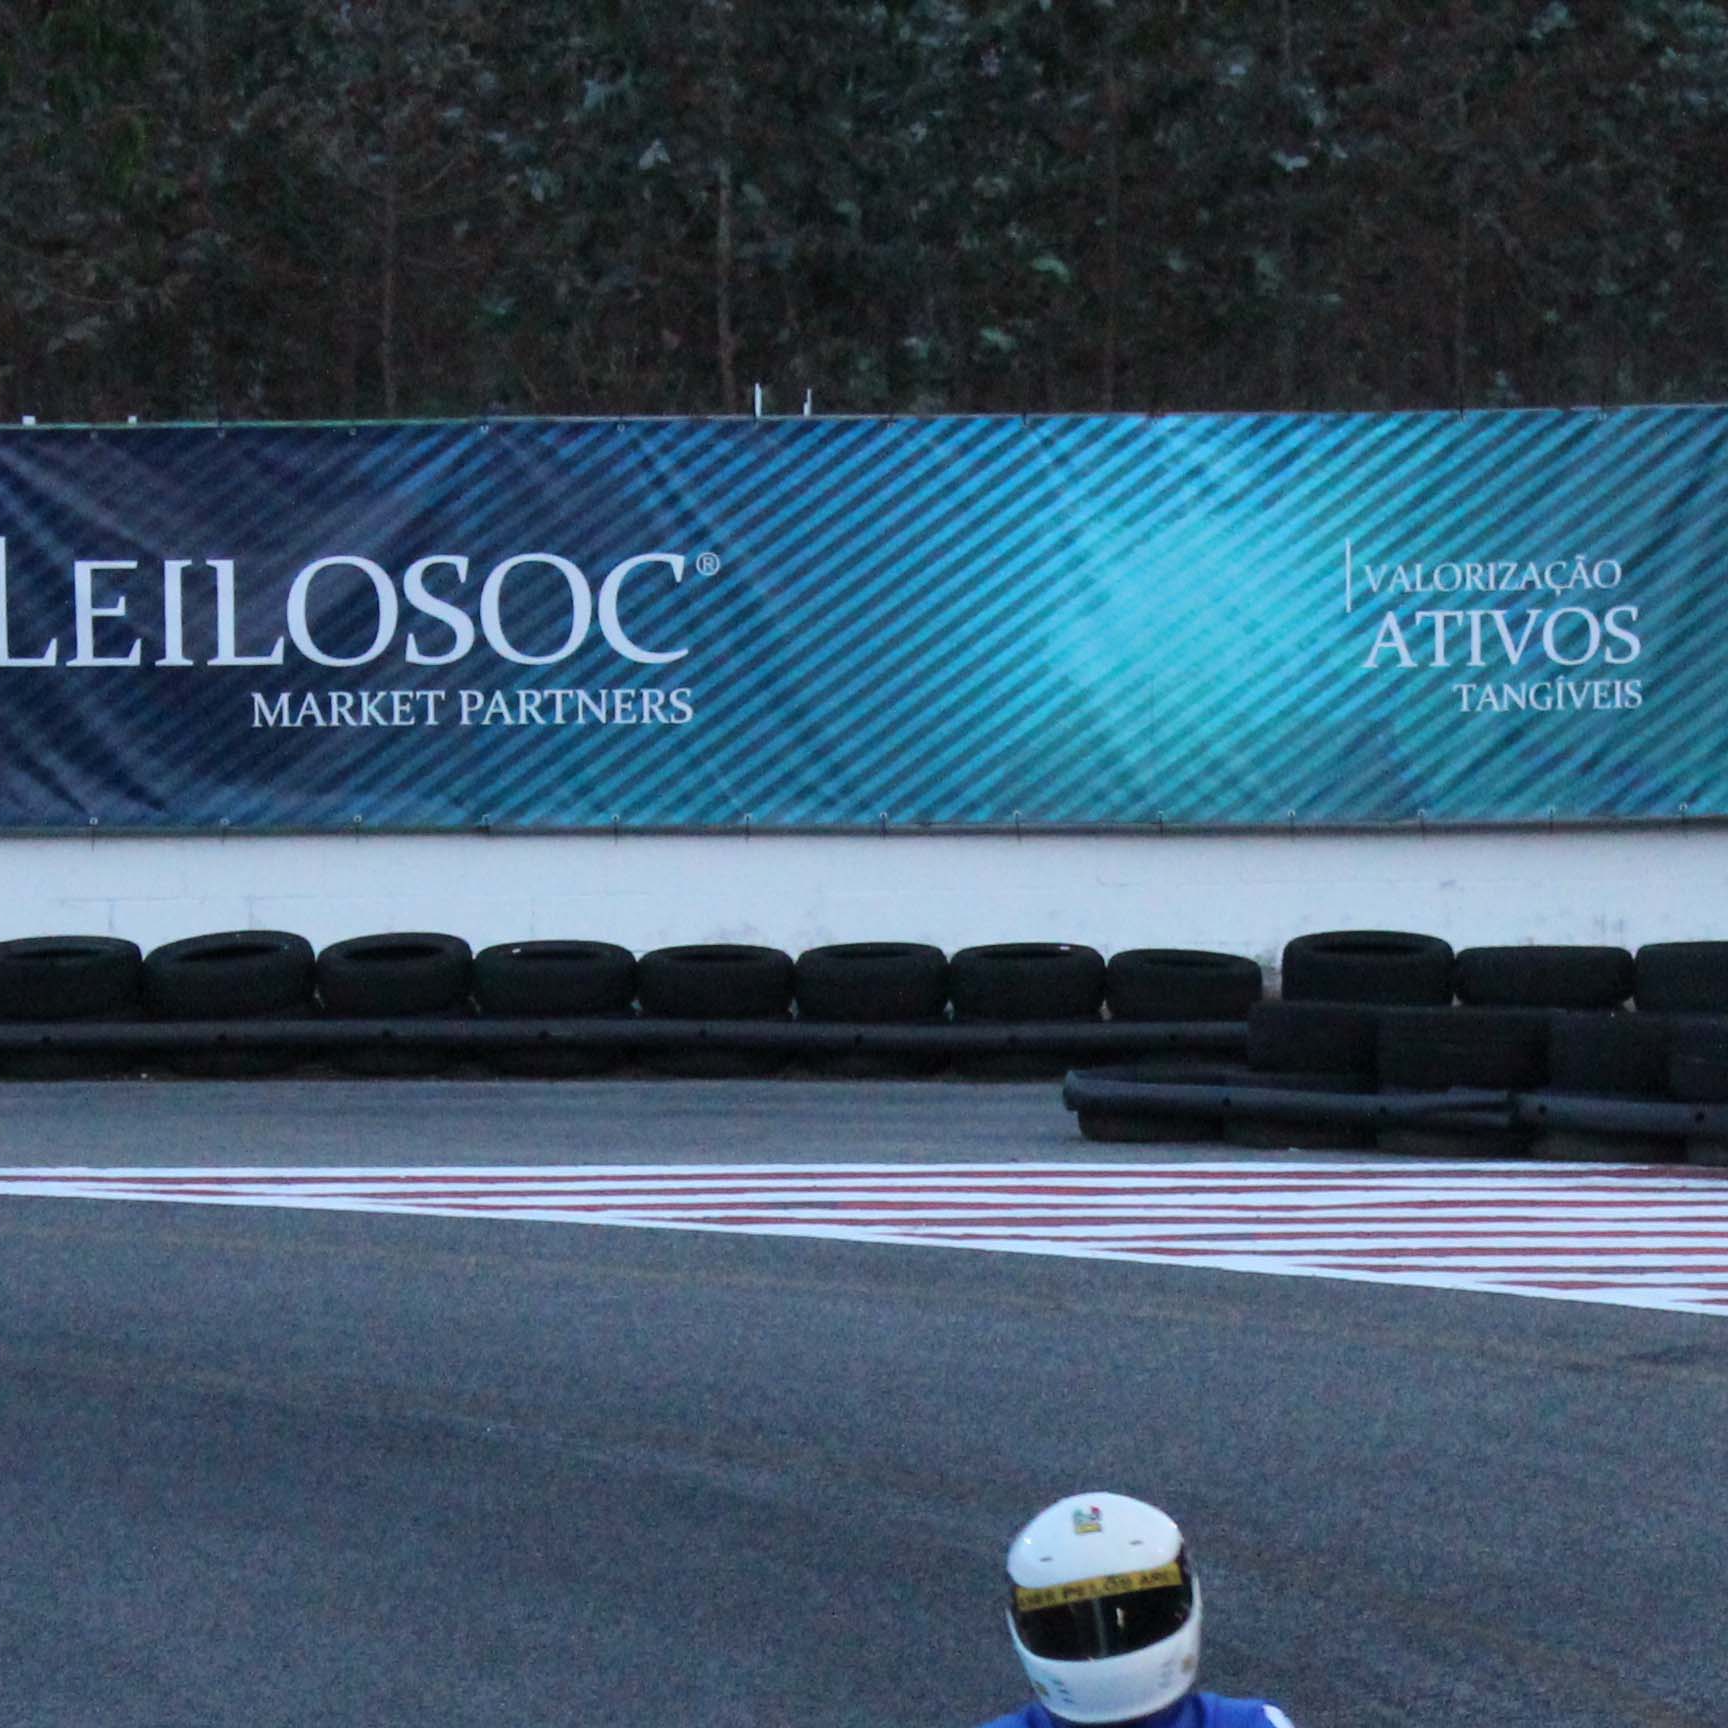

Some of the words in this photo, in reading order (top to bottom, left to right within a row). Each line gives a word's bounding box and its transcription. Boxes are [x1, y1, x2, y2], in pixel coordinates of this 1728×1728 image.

[1362, 554, 1623, 599] VALORIZAÇÃO
[1362, 604, 1642, 669] ATIVOS
[251, 689, 446, 728] MARKET
[459, 686, 694, 725] PARTNERS
[1453, 674, 1643, 713] TANGÍVEIS
